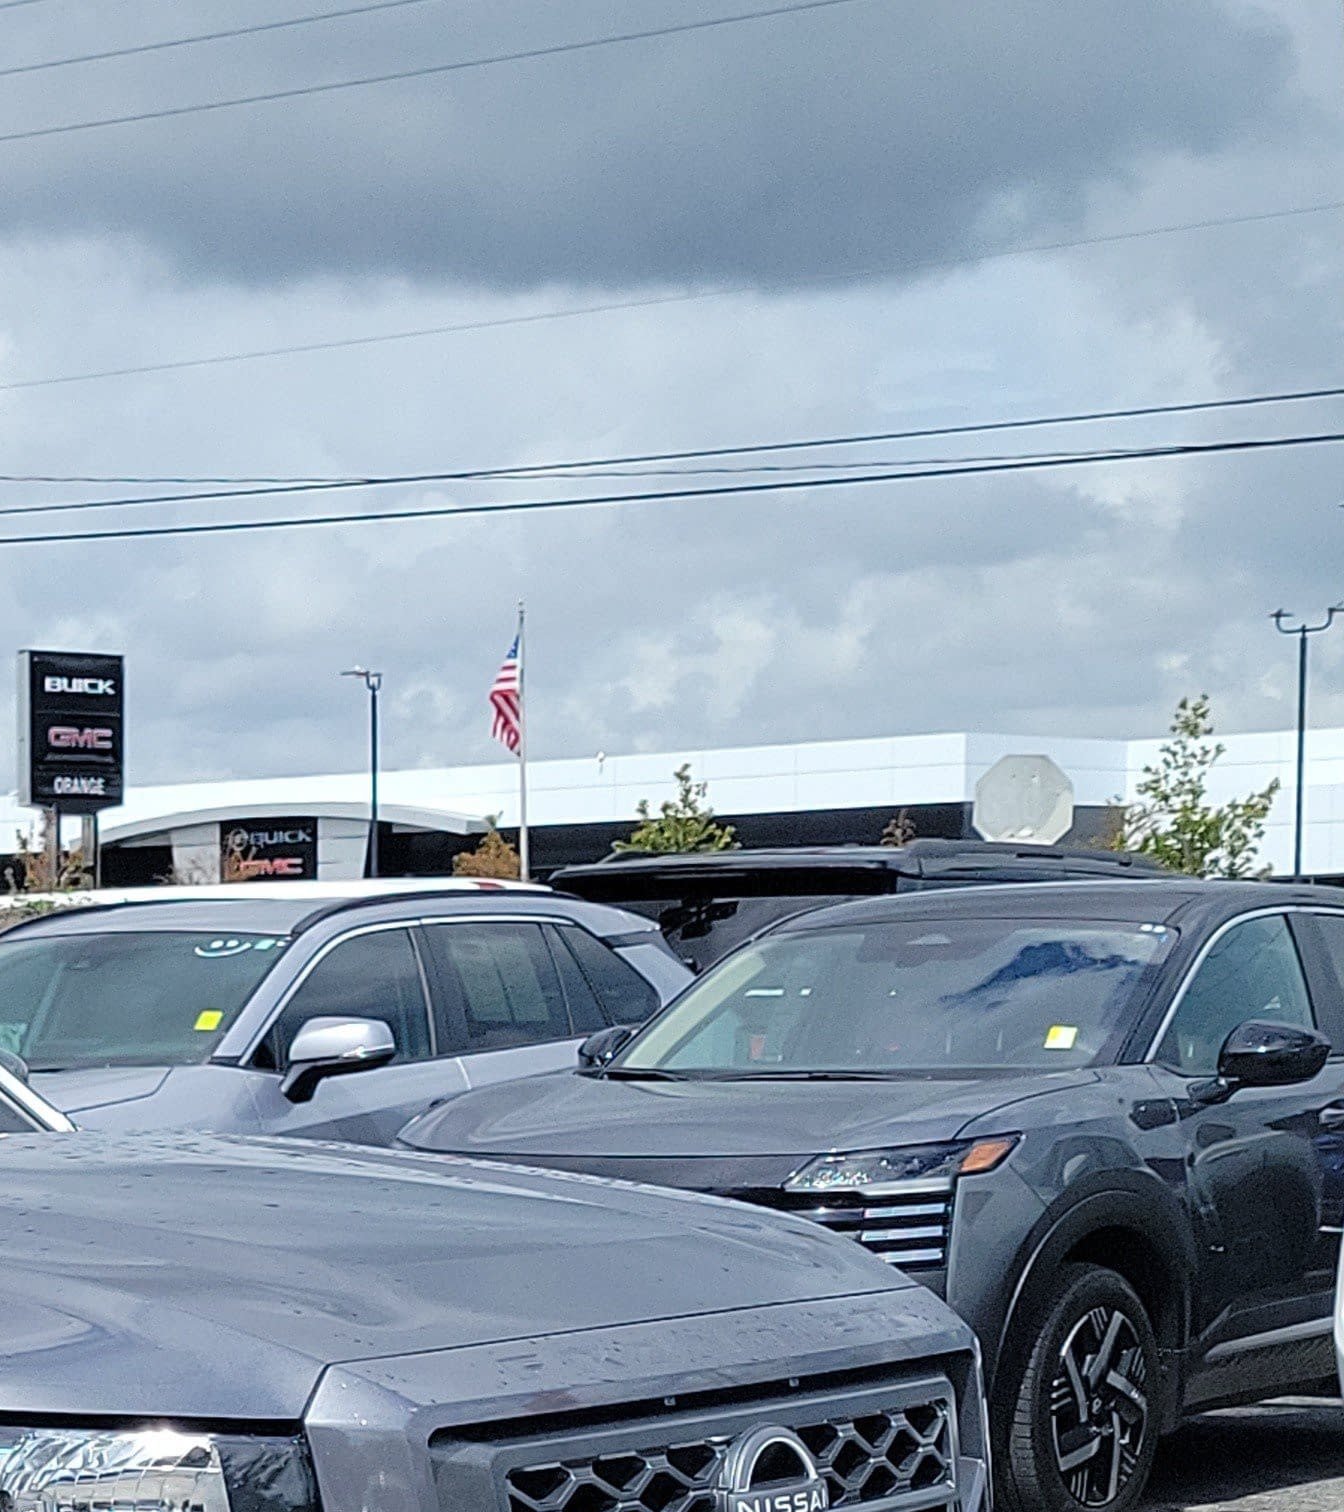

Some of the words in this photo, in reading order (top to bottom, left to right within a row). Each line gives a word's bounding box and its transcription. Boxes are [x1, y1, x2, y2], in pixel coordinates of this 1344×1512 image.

[44, 676, 116, 695] BUICK
[47, 726, 113, 749] GMC
[53, 776, 105, 795] ORANGE
[249, 829, 312, 846] BUICK
